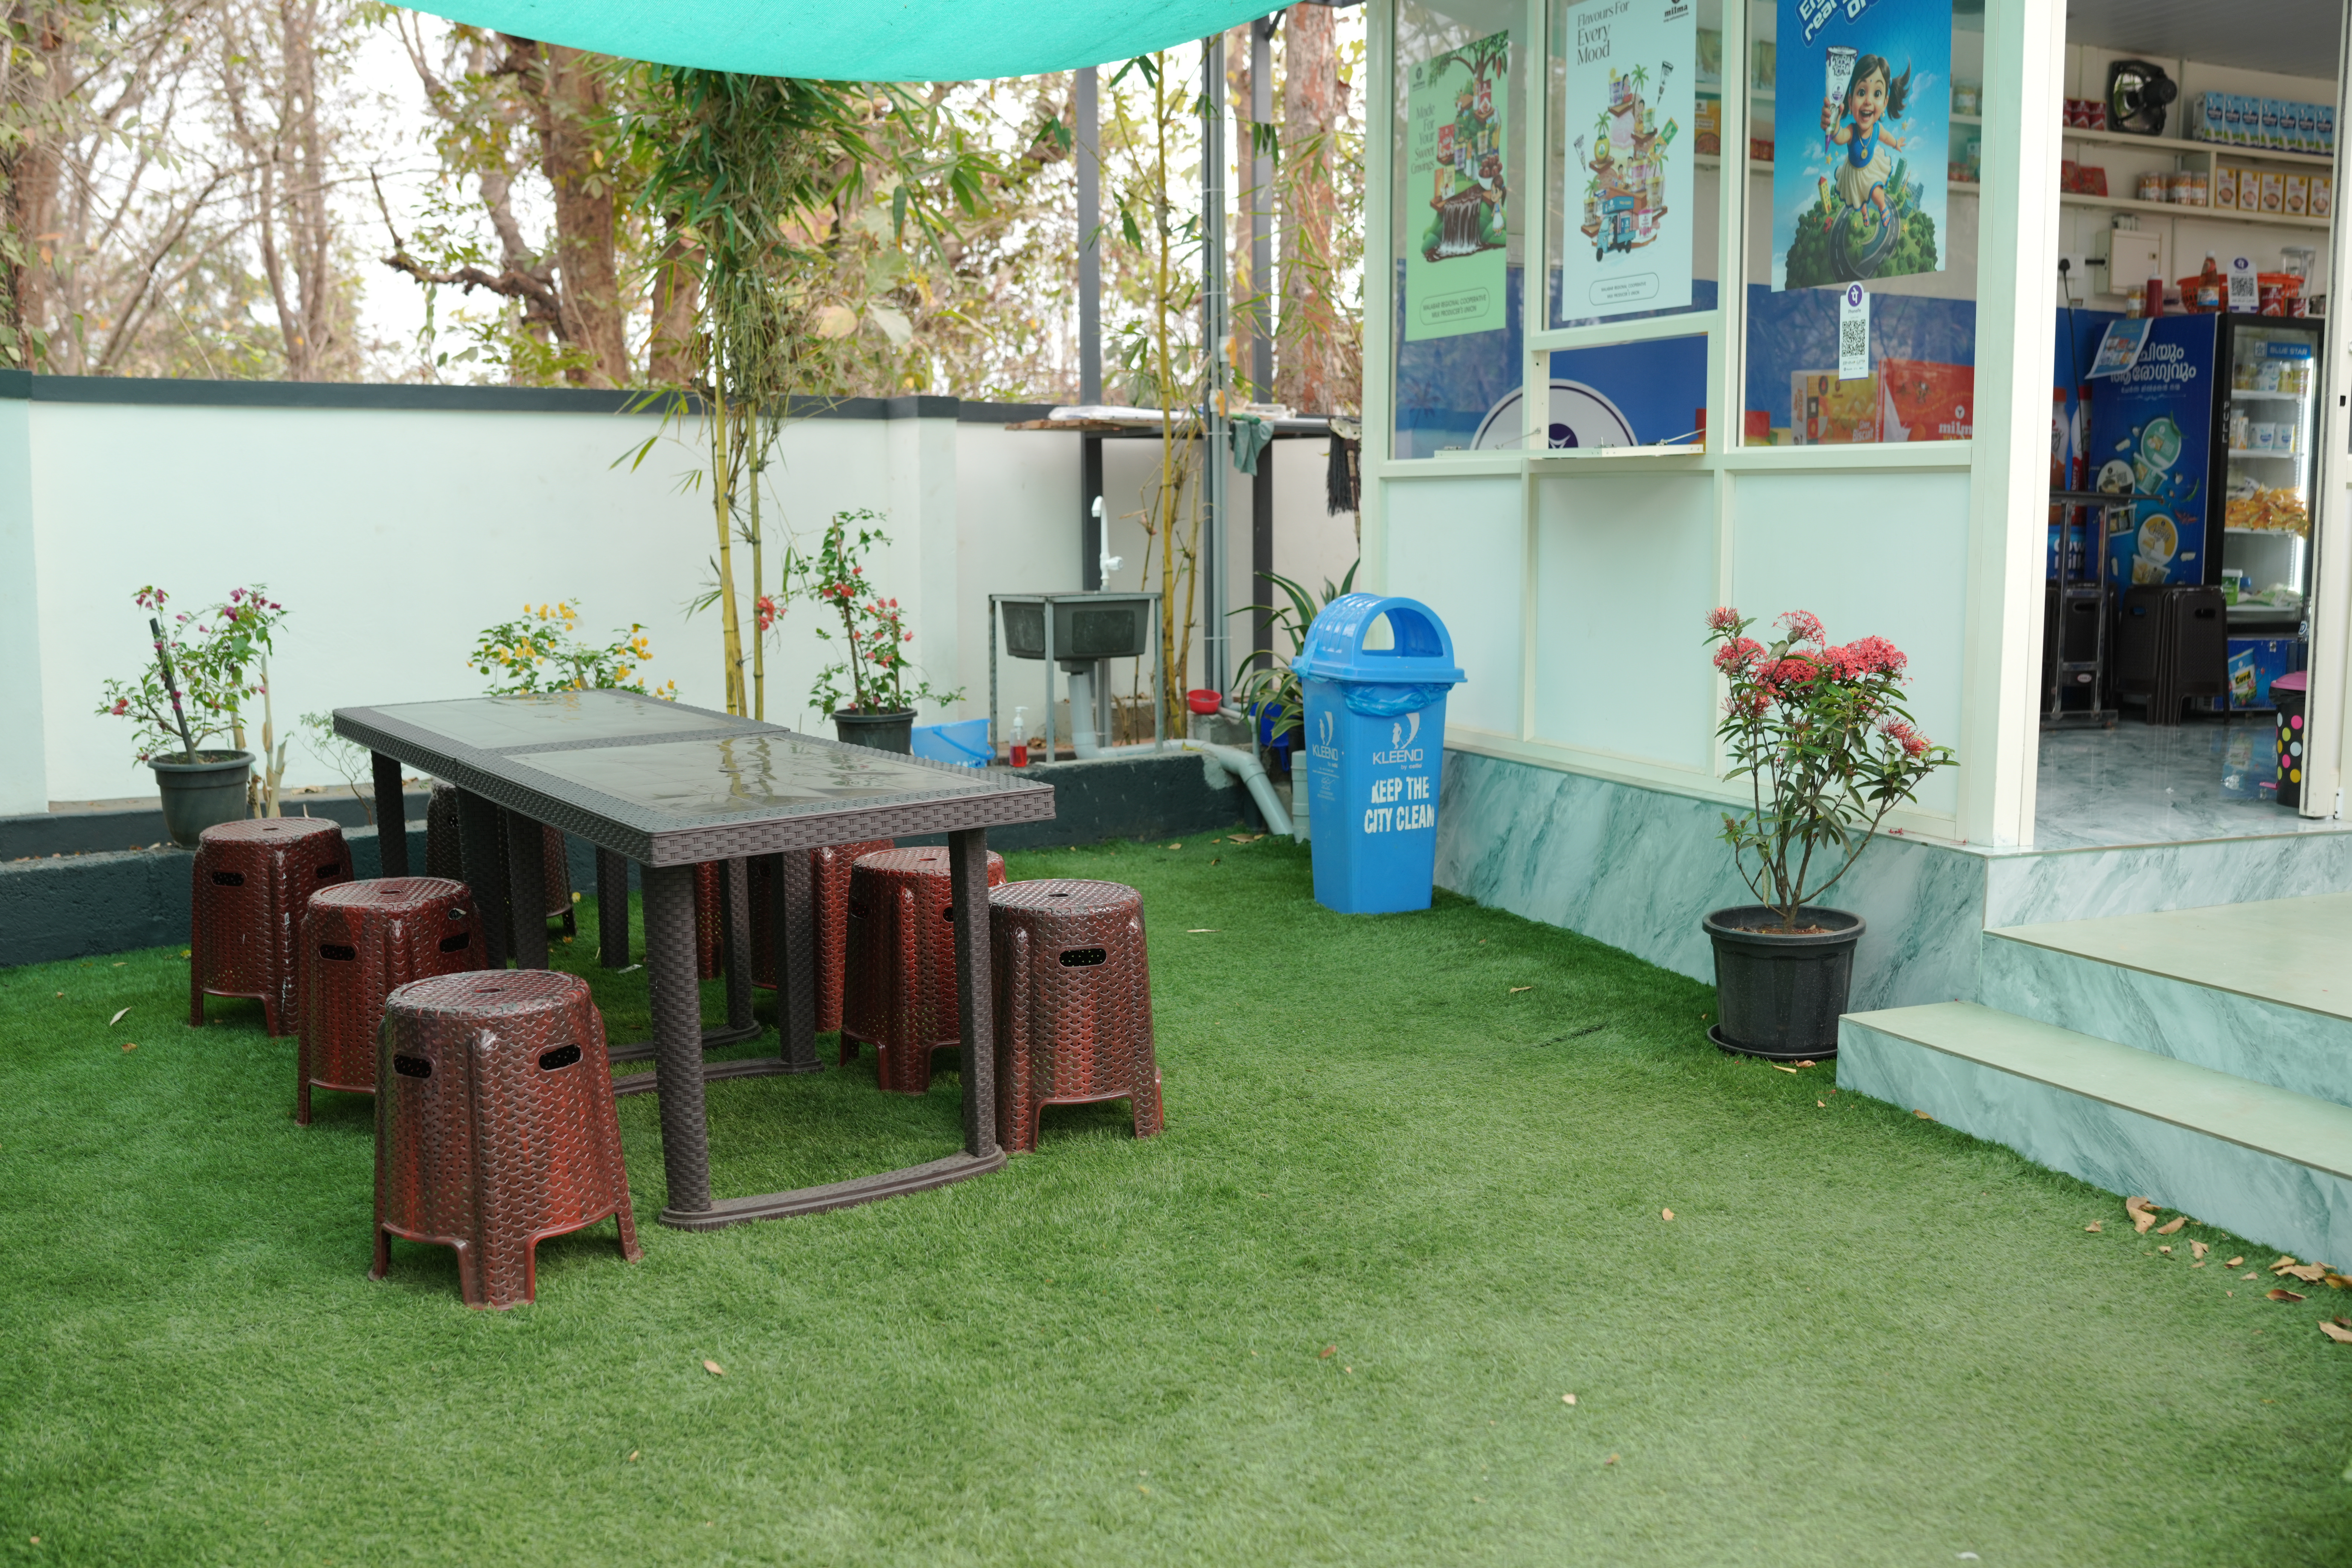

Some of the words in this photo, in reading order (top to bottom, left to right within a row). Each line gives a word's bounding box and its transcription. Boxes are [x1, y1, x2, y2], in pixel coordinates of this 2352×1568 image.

[1578, 7, 1613, 28] Flavours
[1615, 1, 1630, 15] For
[1665, 5, 1687, 17] milma
[1578, 23, 1611, 47] Every
[1577, 39, 1610, 66] Mood
[1416, 103, 1435, 120] Made
[1423, 118, 1435, 132] For
[1419, 132, 1435, 145] Your
[1415, 146, 1434, 161] Sweet
[1411, 161, 1434, 175] Cravings
[1423, 303, 1440, 311] MALABAR
[1441, 299, 1459, 308] REGIONAL
[1460, 294, 1486, 305] COOPERATIVE
[2270, 346, 2288, 354] BLUE
[2290, 347, 2308, 355] STAR
[1853, 426, 1874, 443] Biscuit
[1939, 420, 1972, 435] milm
[1312, 744, 1338, 761] KLEENO
[1373, 749, 1423, 765] KLEENO
[1371, 777, 1403, 804] KEEP
[1406, 776, 1430, 800] THE
[1364, 807, 1393, 834] CITY
[1396, 804, 1435, 831] CLEAN
